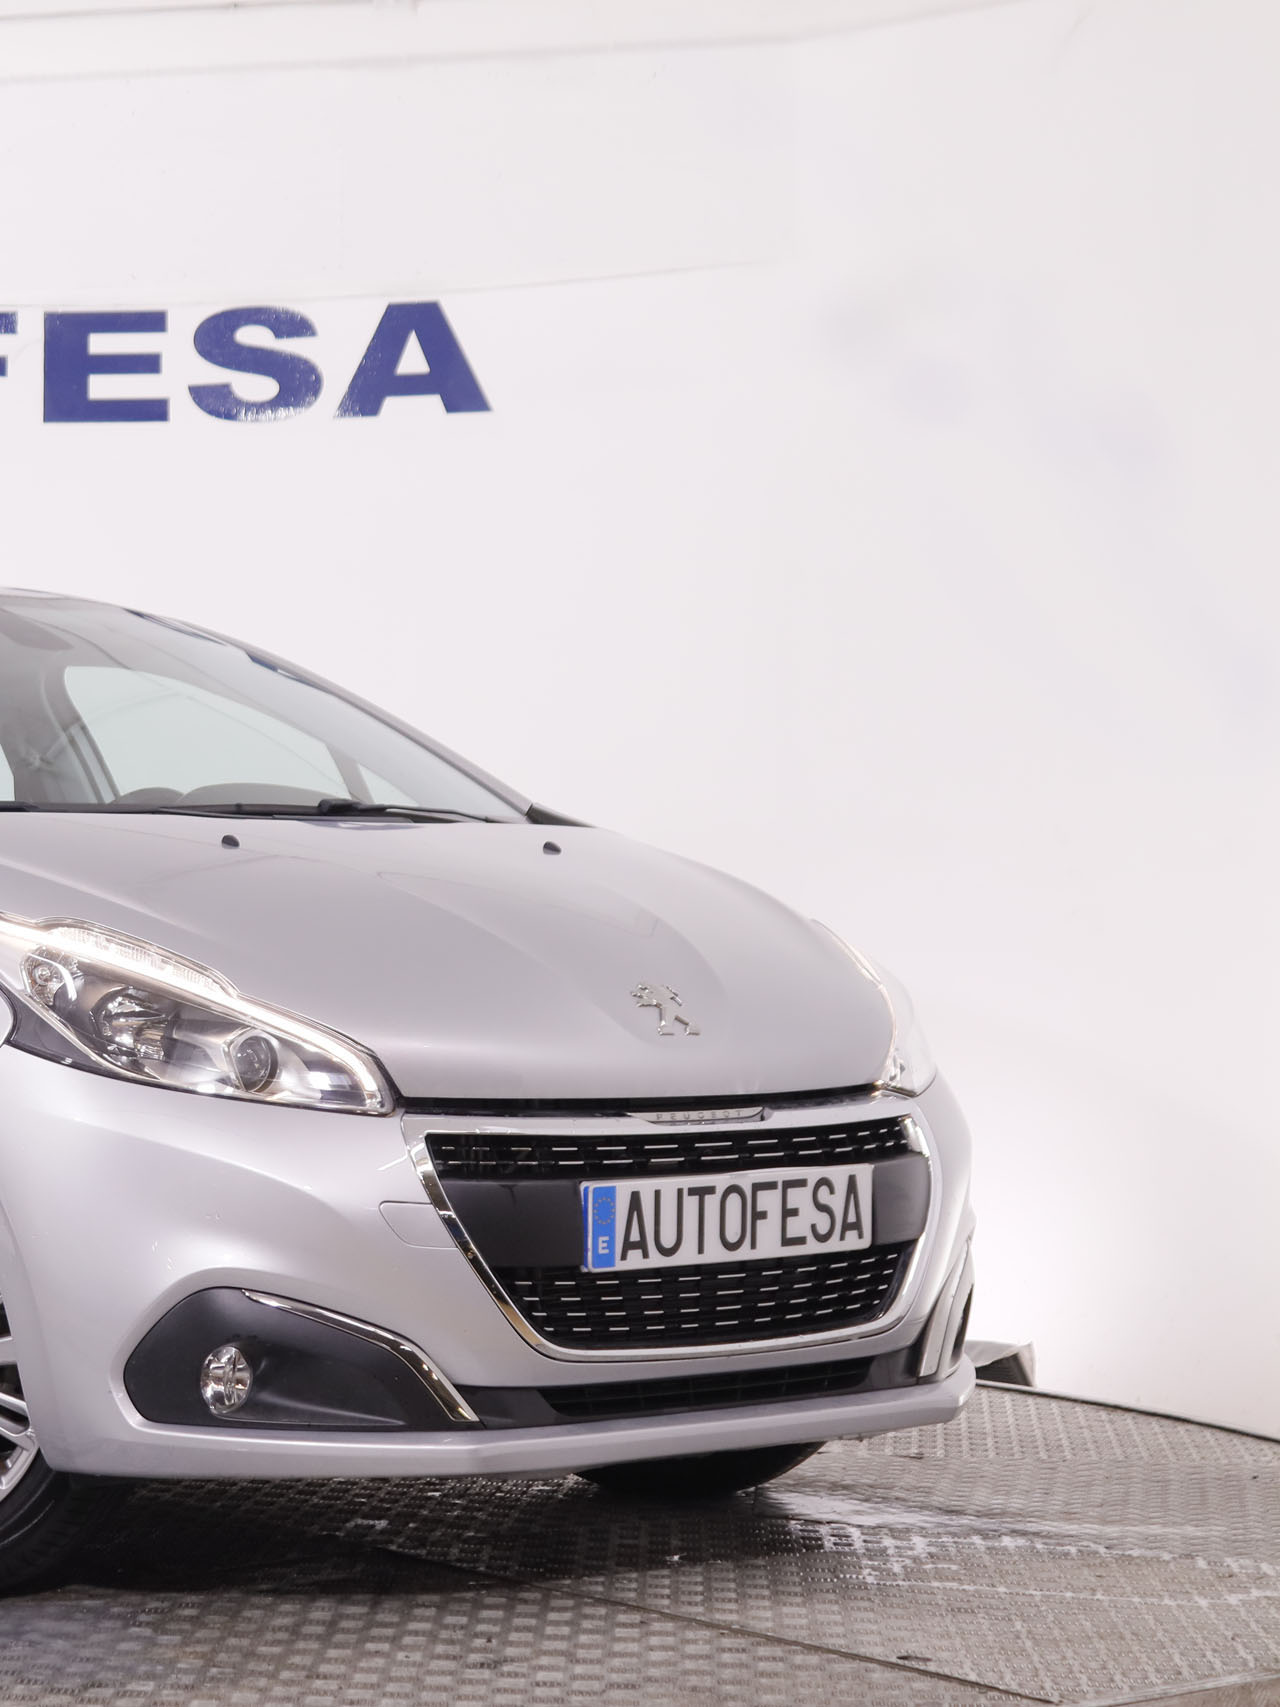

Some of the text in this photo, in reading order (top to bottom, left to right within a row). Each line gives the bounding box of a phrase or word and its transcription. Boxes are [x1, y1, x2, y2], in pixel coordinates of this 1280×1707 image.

[656, 1109, 743, 1121] PEUGEOT
[620, 1174, 864, 1261] AUTOFESA
[598, 1236, 610, 1255] E
